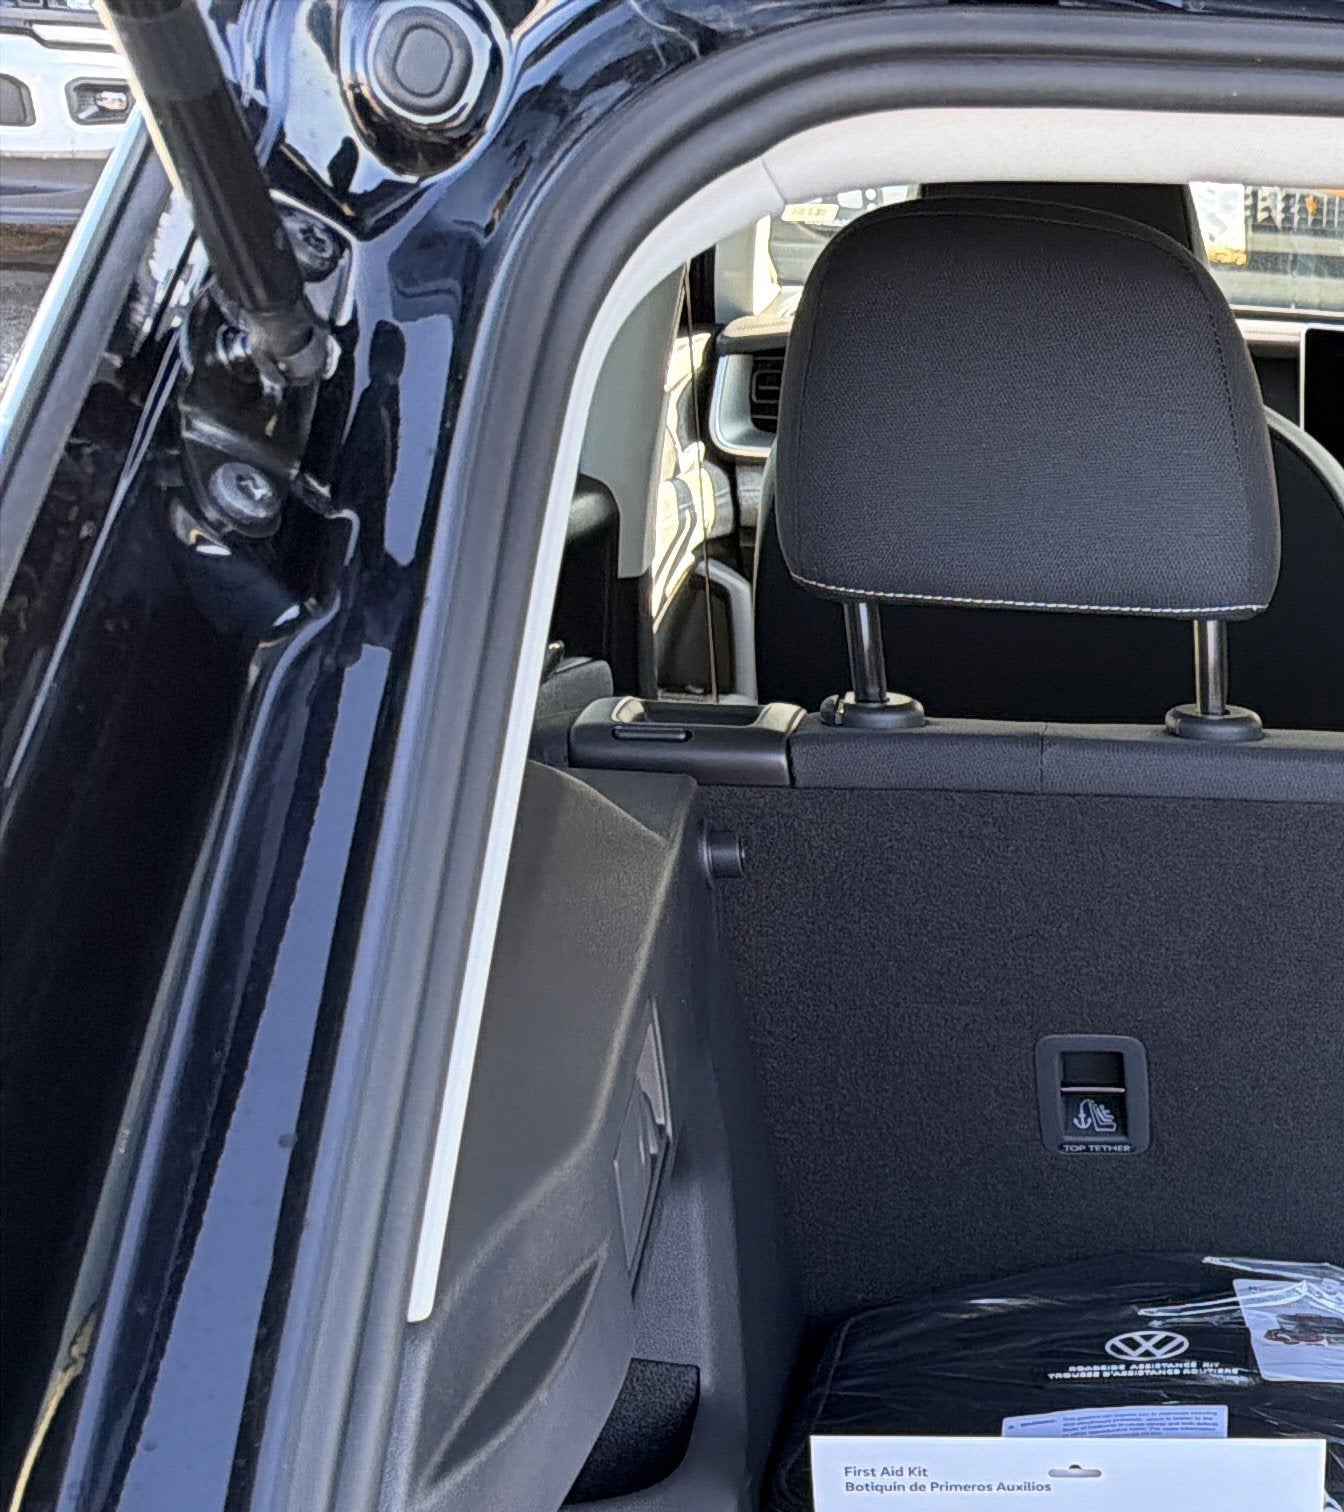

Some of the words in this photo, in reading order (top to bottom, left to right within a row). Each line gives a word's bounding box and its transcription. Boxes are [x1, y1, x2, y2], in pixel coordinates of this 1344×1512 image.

[1063, 1144, 1086, 1152] TOP
[1088, 1144, 1131, 1152] TETHER
[1069, 1364, 1125, 1372] ROADSIDE
[1130, 1362, 1197, 1371] ASSISTANCE
[1048, 1371, 1100, 1379] TROUSSE
[844, 1466, 876, 1477] First
[880, 1466, 904, 1477] Aid
[908, 1466, 929, 1477] Kit
[909, 1481, 926, 1492] de
[930, 1481, 993, 1492] Primeros
[996, 1481, 1052, 1492] Auxilios
